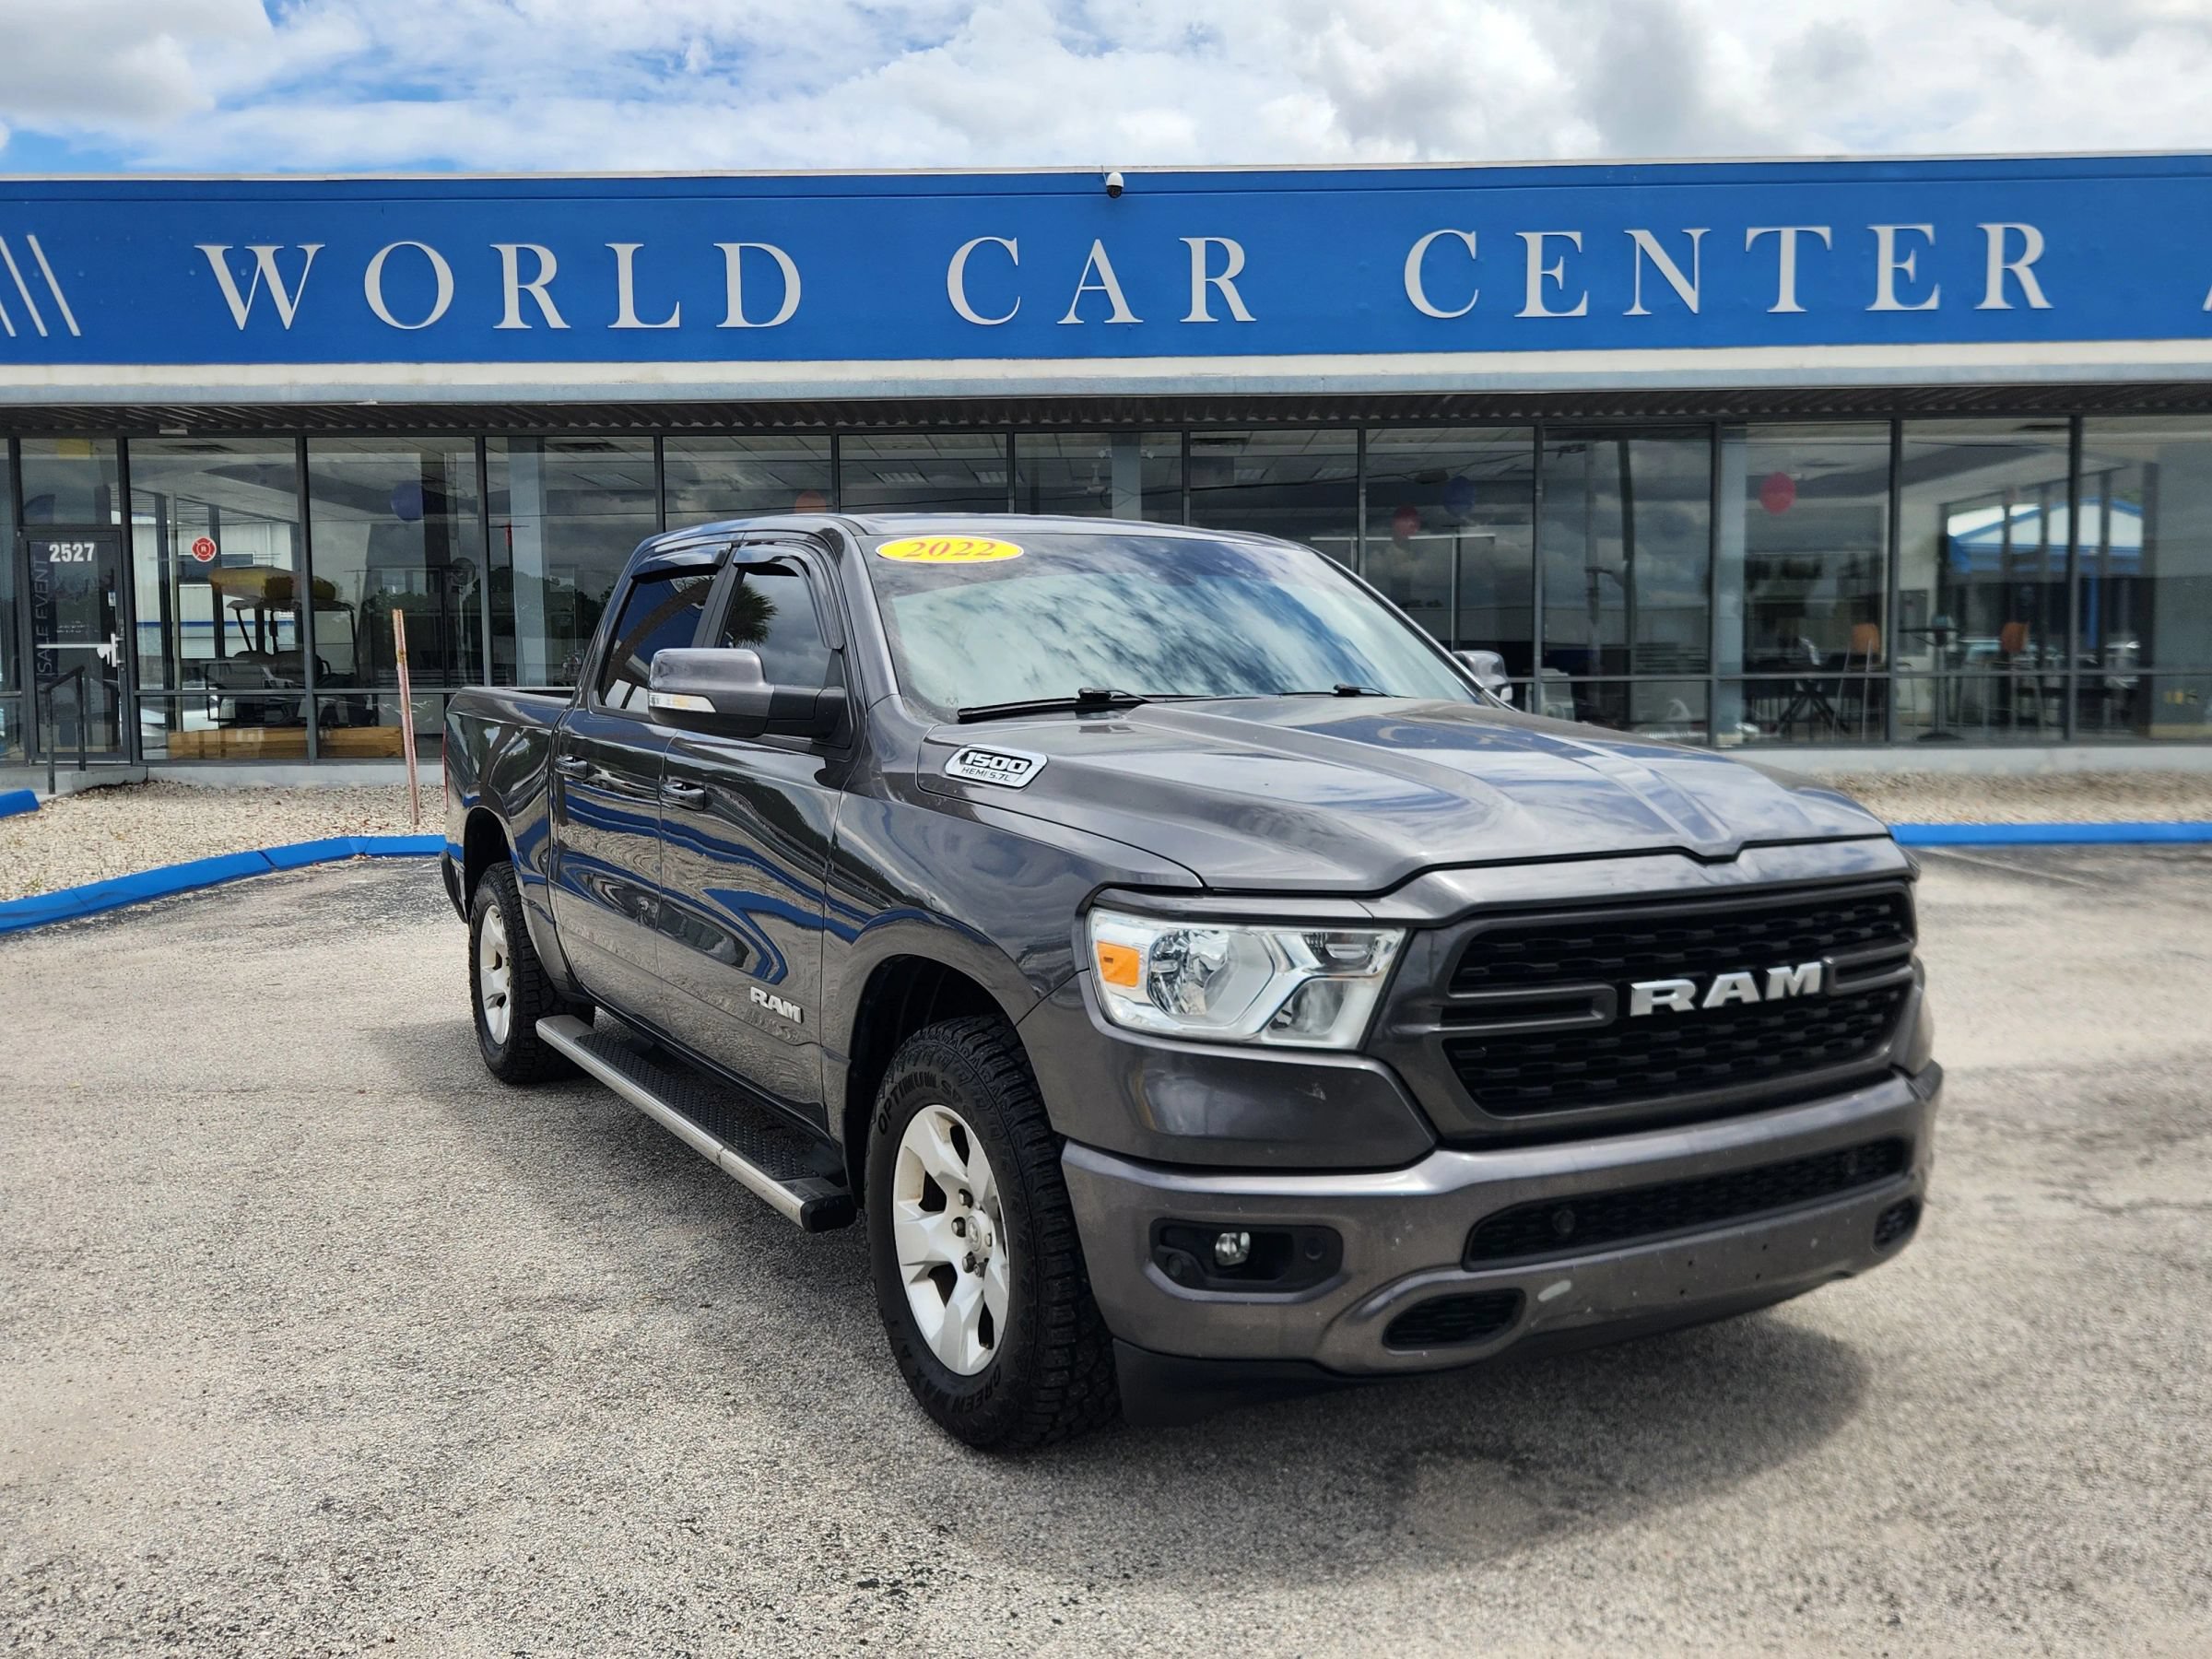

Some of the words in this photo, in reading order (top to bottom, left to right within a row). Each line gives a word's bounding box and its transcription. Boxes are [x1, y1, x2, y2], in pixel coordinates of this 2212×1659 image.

[194, 240, 801, 331] WORLD
[947, 236, 1257, 325] CAR
[1404, 223, 2053, 318] CENTER
[49, 543, 96, 562] 2527
[902, 541, 996, 558] 2022
[33, 556, 50, 619] EVENT
[961, 766, 988, 778] HEMI
[988, 769, 1011, 782] 5.7L
[965, 751, 1030, 774] 1500
[1630, 961, 1822, 1017] RAM
[750, 986, 802, 1024] RAM
